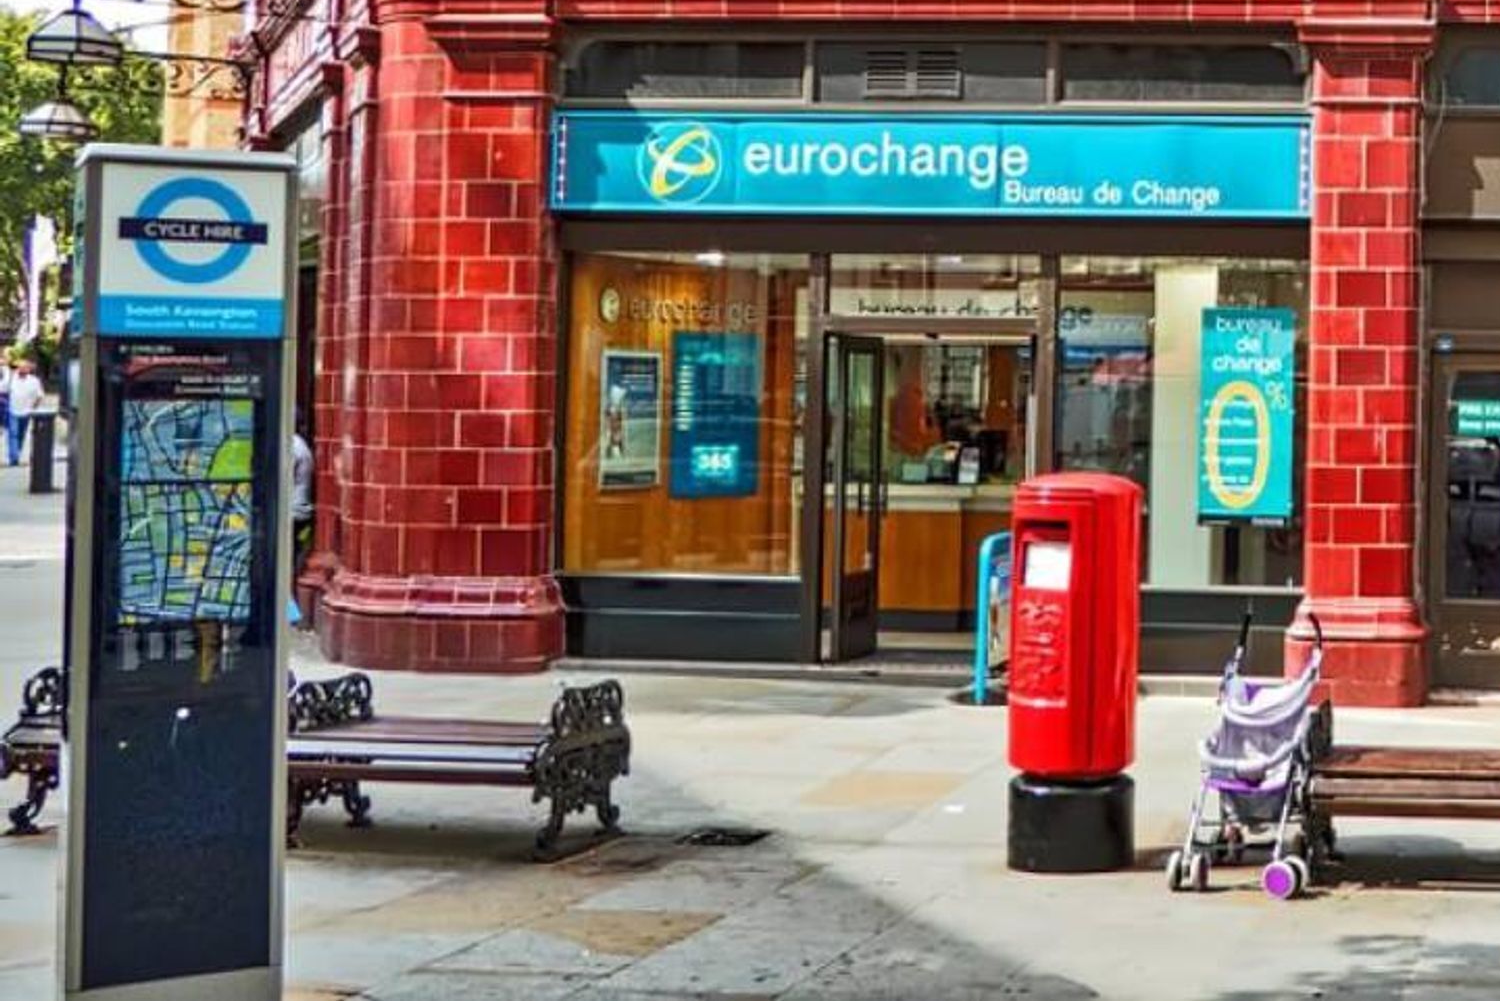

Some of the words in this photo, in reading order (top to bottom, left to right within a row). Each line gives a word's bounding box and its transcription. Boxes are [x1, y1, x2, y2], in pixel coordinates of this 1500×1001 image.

[743, 131, 1030, 190] eurochange
[1004, 180, 1084, 205] Bureau
[1093, 181, 1122, 205] de
[1131, 180, 1221, 211] Change
[144, 221, 198, 238] CYCLE
[203, 225, 244, 240] HIRE
[125, 303, 170, 318] South
[173, 305, 258, 320] Kensington
[1215, 315, 1283, 334] bureau
[1235, 334, 1263, 353] de
[1211, 354, 1283, 376] change
